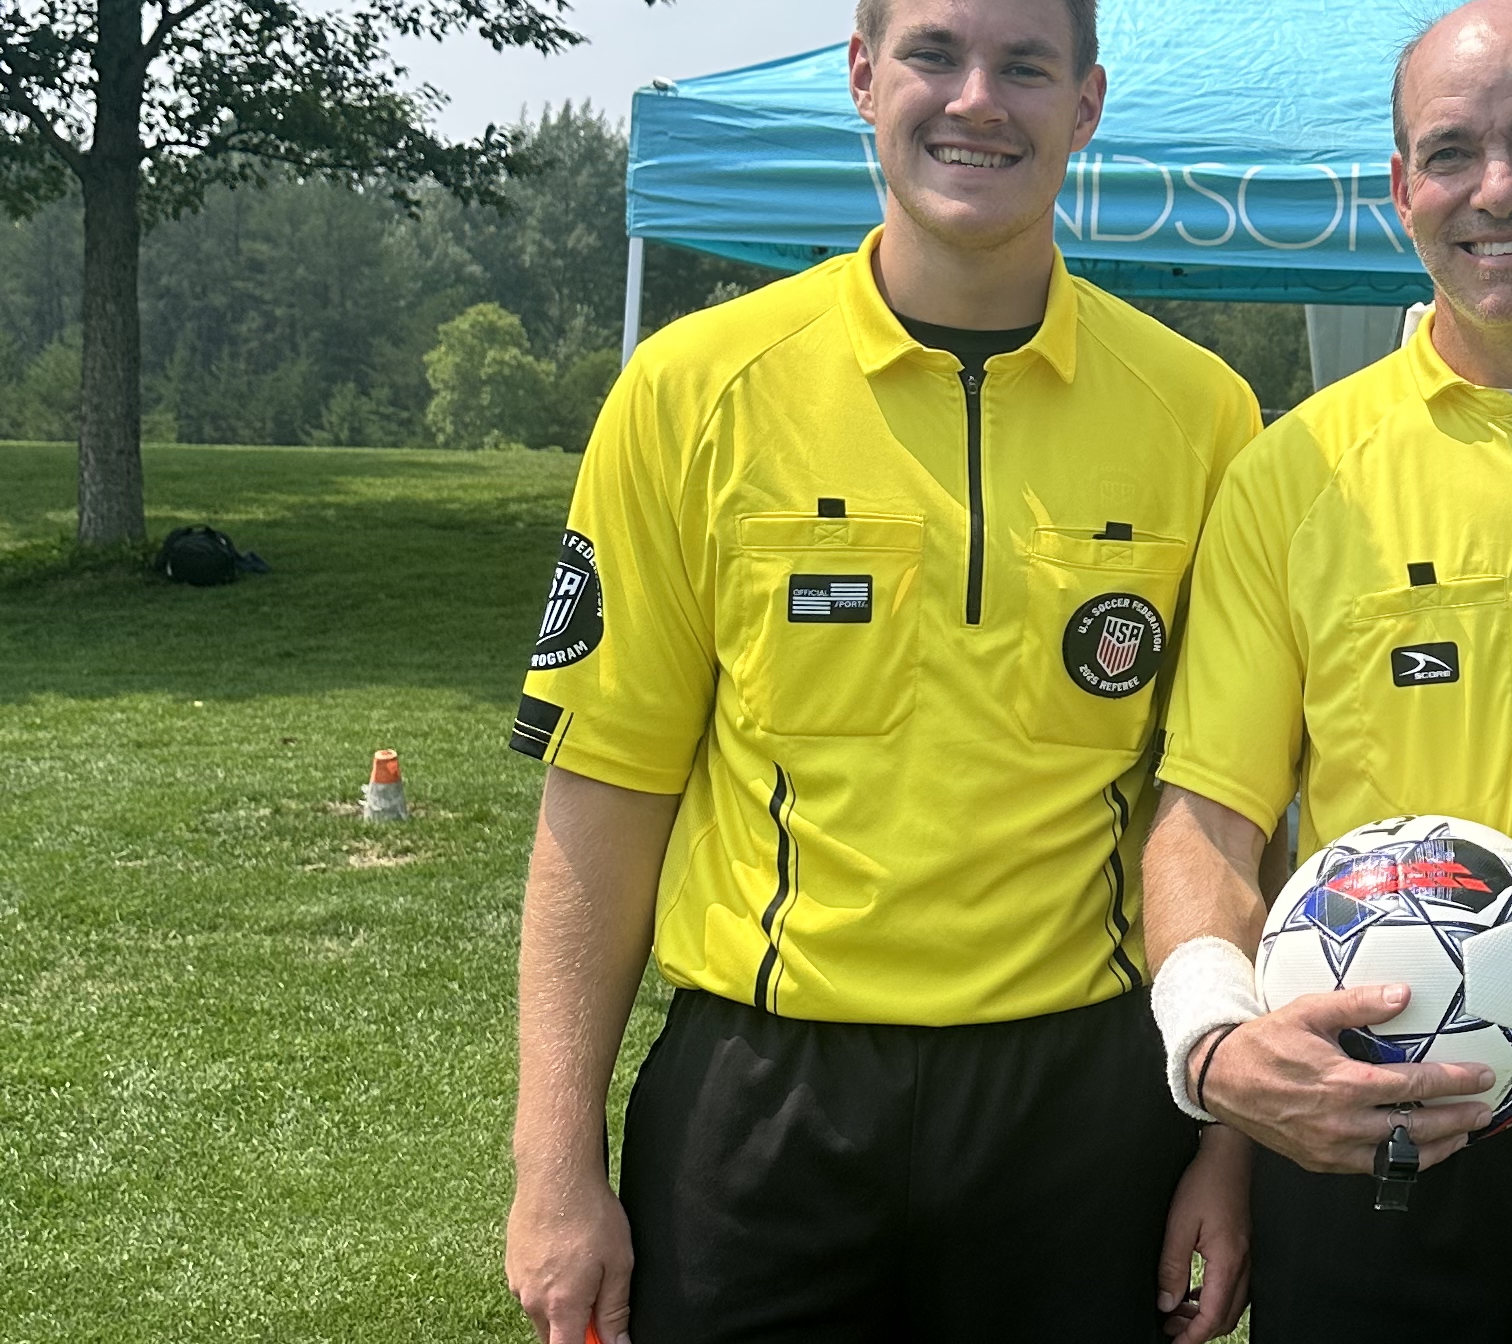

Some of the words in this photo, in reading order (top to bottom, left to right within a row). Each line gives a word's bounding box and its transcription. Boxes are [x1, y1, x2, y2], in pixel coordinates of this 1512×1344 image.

[793, 588, 830, 597] OFFICIAL
[1091, 598, 1130, 617] SOCCER
[1132, 600, 1162, 652] FEDERATION
[1104, 619, 1142, 644] USA
[1099, 676, 1140, 692] REFEREE
